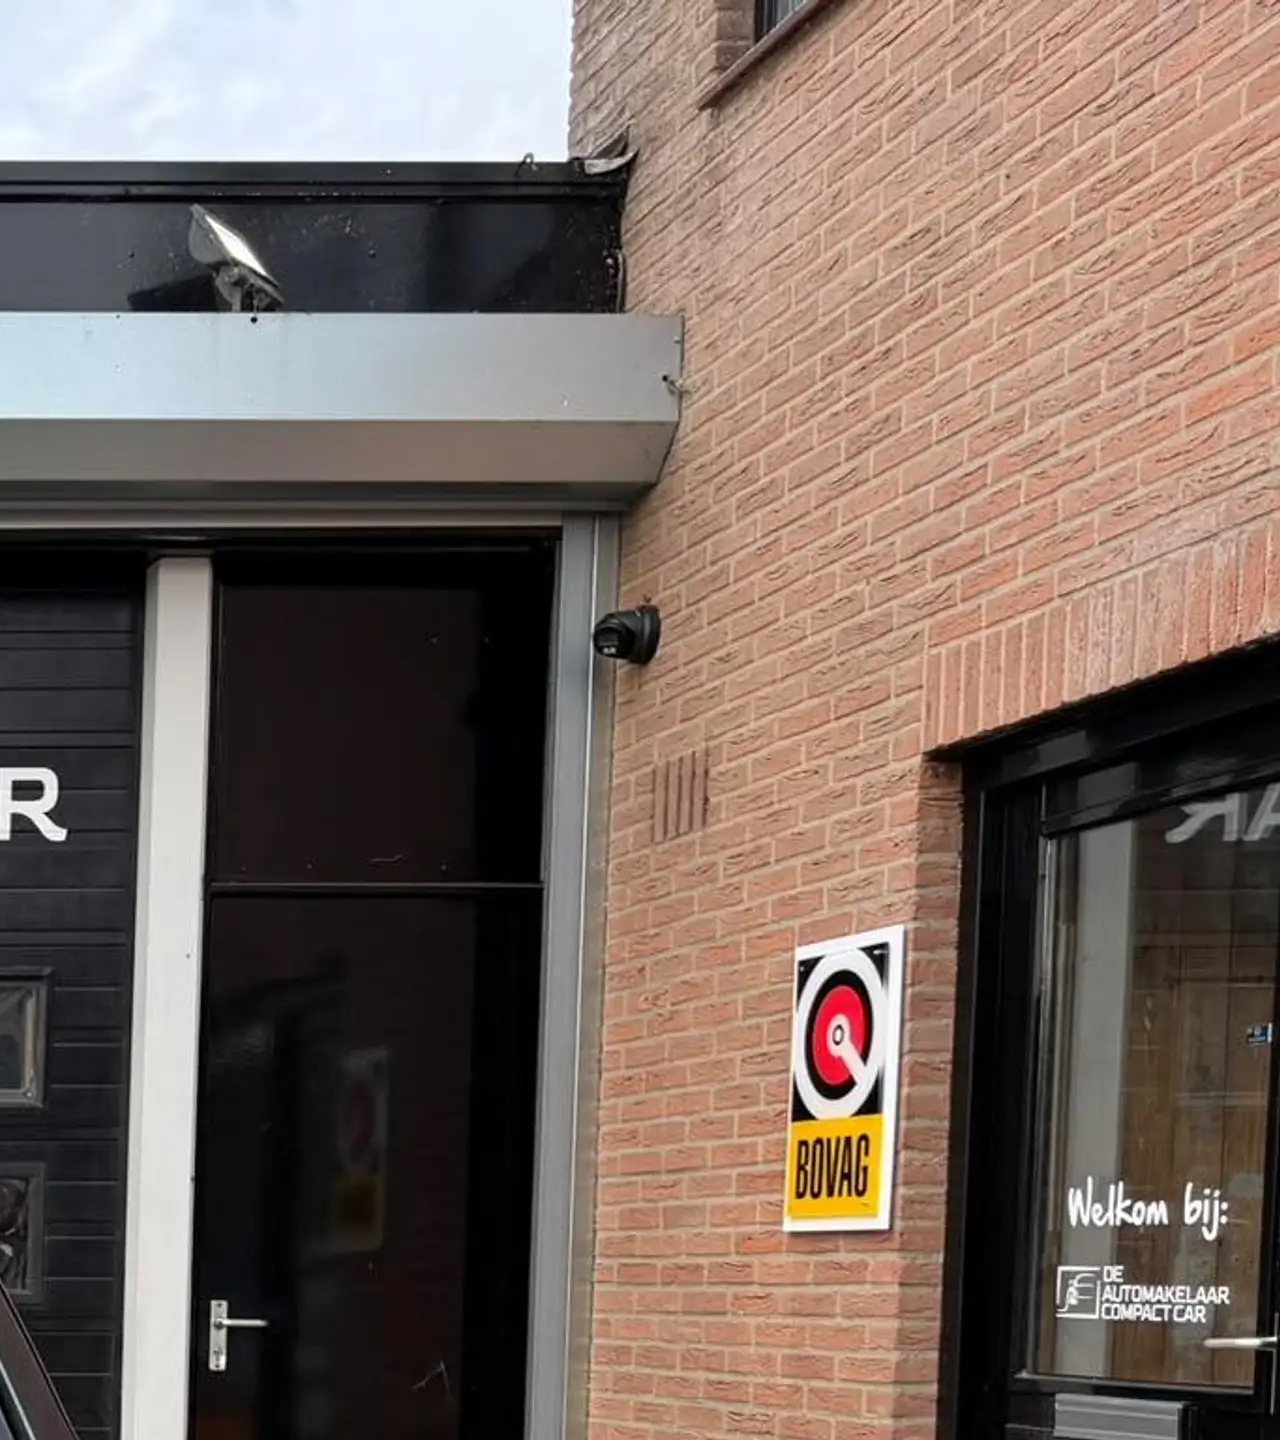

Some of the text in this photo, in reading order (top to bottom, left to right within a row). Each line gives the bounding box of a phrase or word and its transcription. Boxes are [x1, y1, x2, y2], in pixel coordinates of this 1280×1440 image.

[794, 1132, 870, 1200] BOVAG
[1068, 1176, 1229, 1241] Welkom bij:
[1103, 1266, 1124, 1282] DE
[1101, 1285, 1230, 1305] AUTOMAKELAAR
[1101, 1304, 1207, 1323] COMPACT CAR
